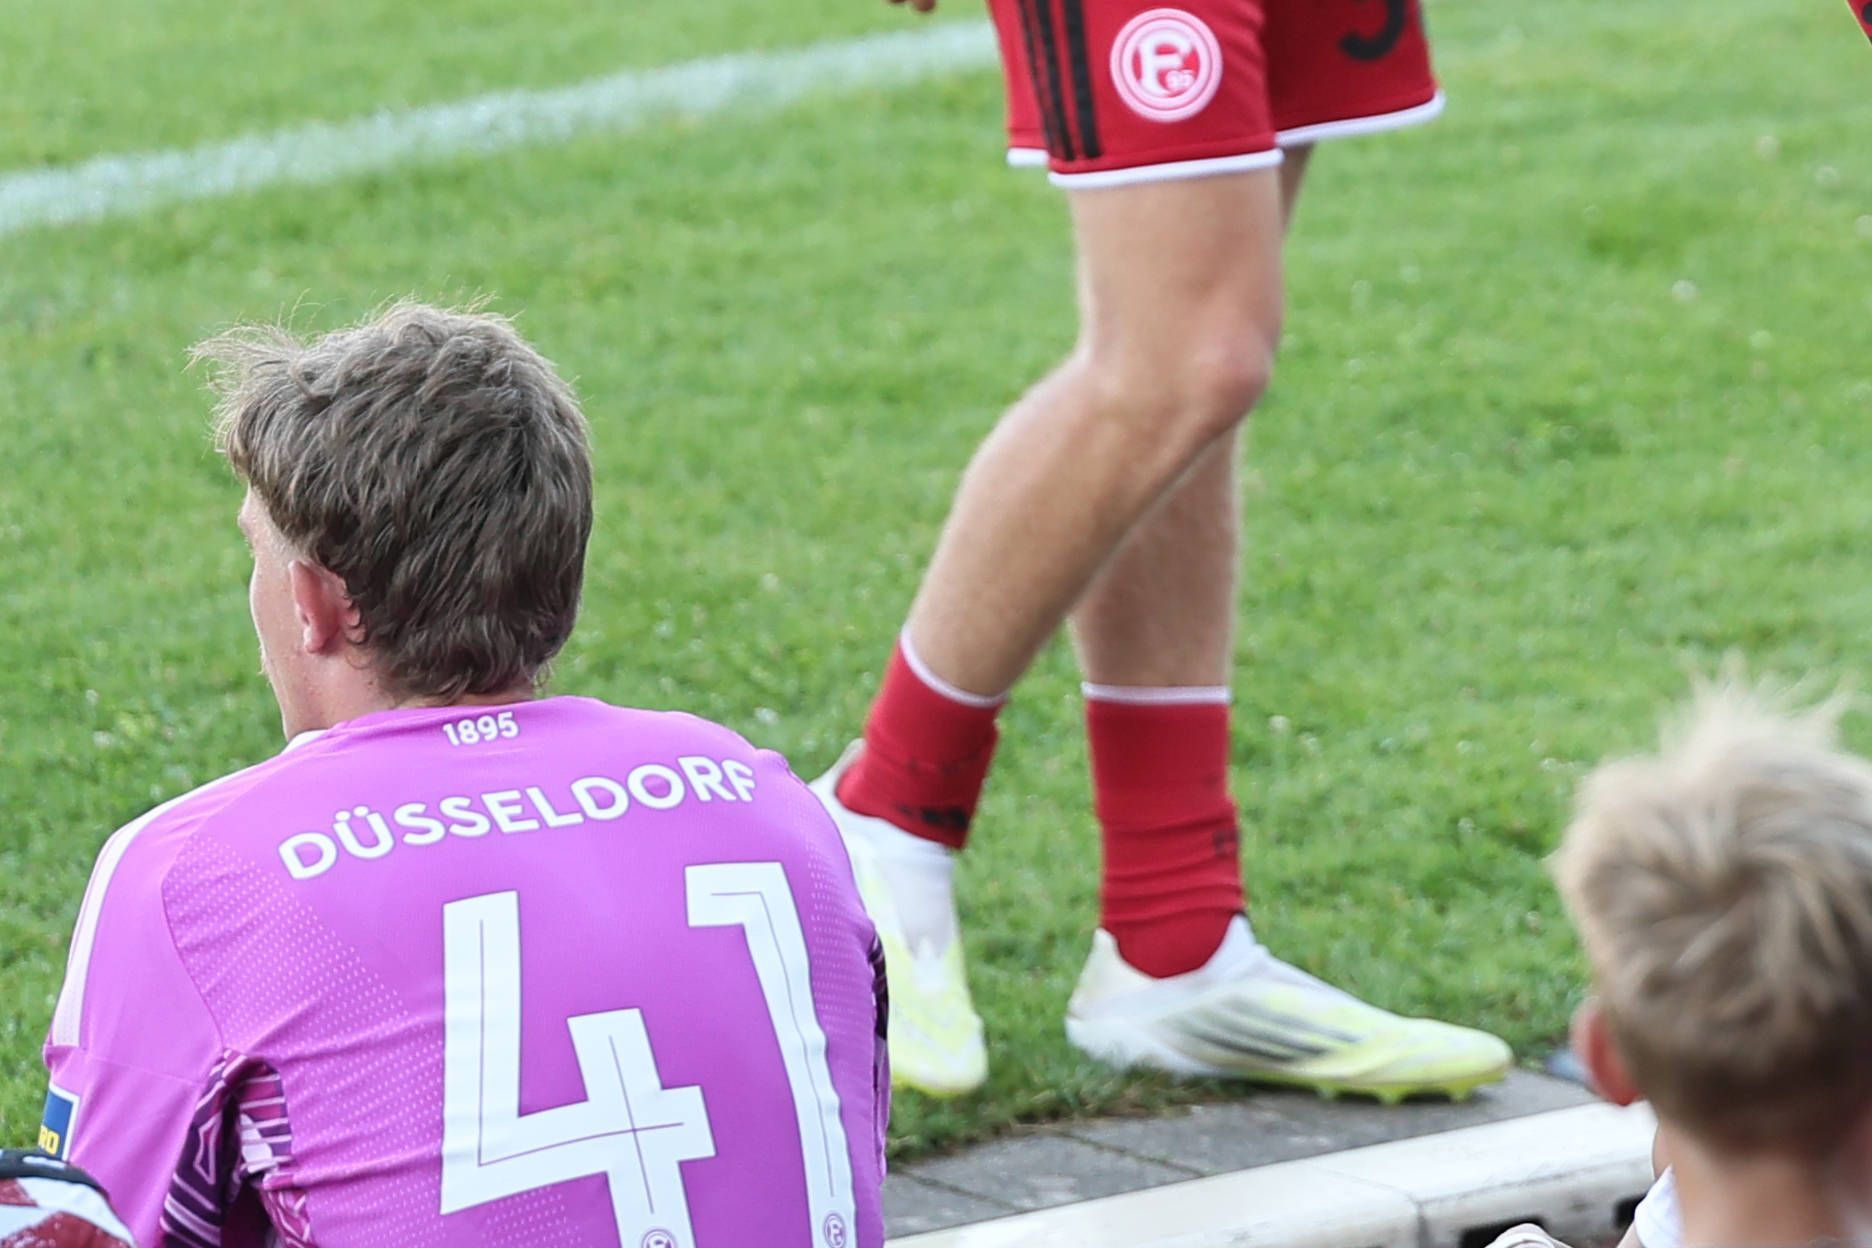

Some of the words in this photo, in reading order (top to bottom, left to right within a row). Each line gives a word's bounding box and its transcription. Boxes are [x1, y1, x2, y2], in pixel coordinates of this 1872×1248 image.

[442, 710, 520, 746] 1895
[279, 755, 757, 880] DÜSSELDORF
[440, 860, 857, 1248] 41
